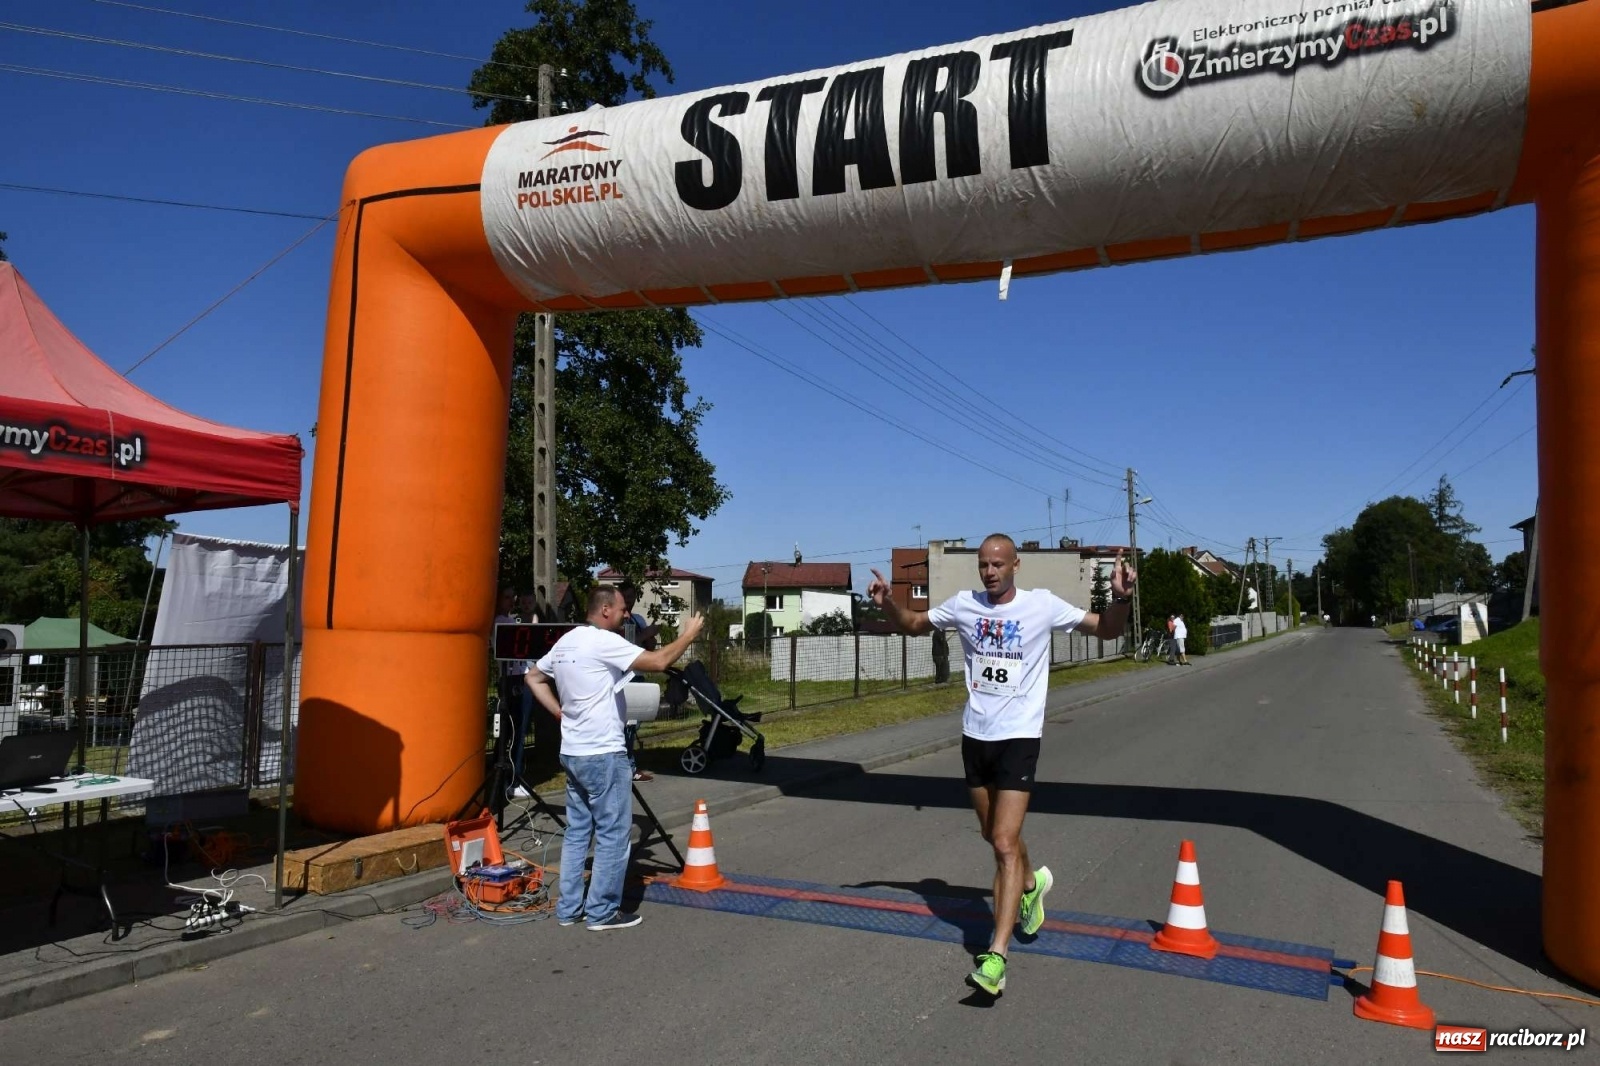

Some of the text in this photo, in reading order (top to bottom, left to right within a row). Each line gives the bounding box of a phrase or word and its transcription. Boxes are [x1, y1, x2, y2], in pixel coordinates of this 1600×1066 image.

[1193, 11, 1308, 42] Elektroniczny
[1188, 7, 1447, 79] ZmierzymyCzas.pl
[675, 29, 1073, 210] START
[518, 159, 622, 188] MARATONY
[518, 181, 623, 209] POLSKIE.PL
[982, 666, 1008, 683] 48
